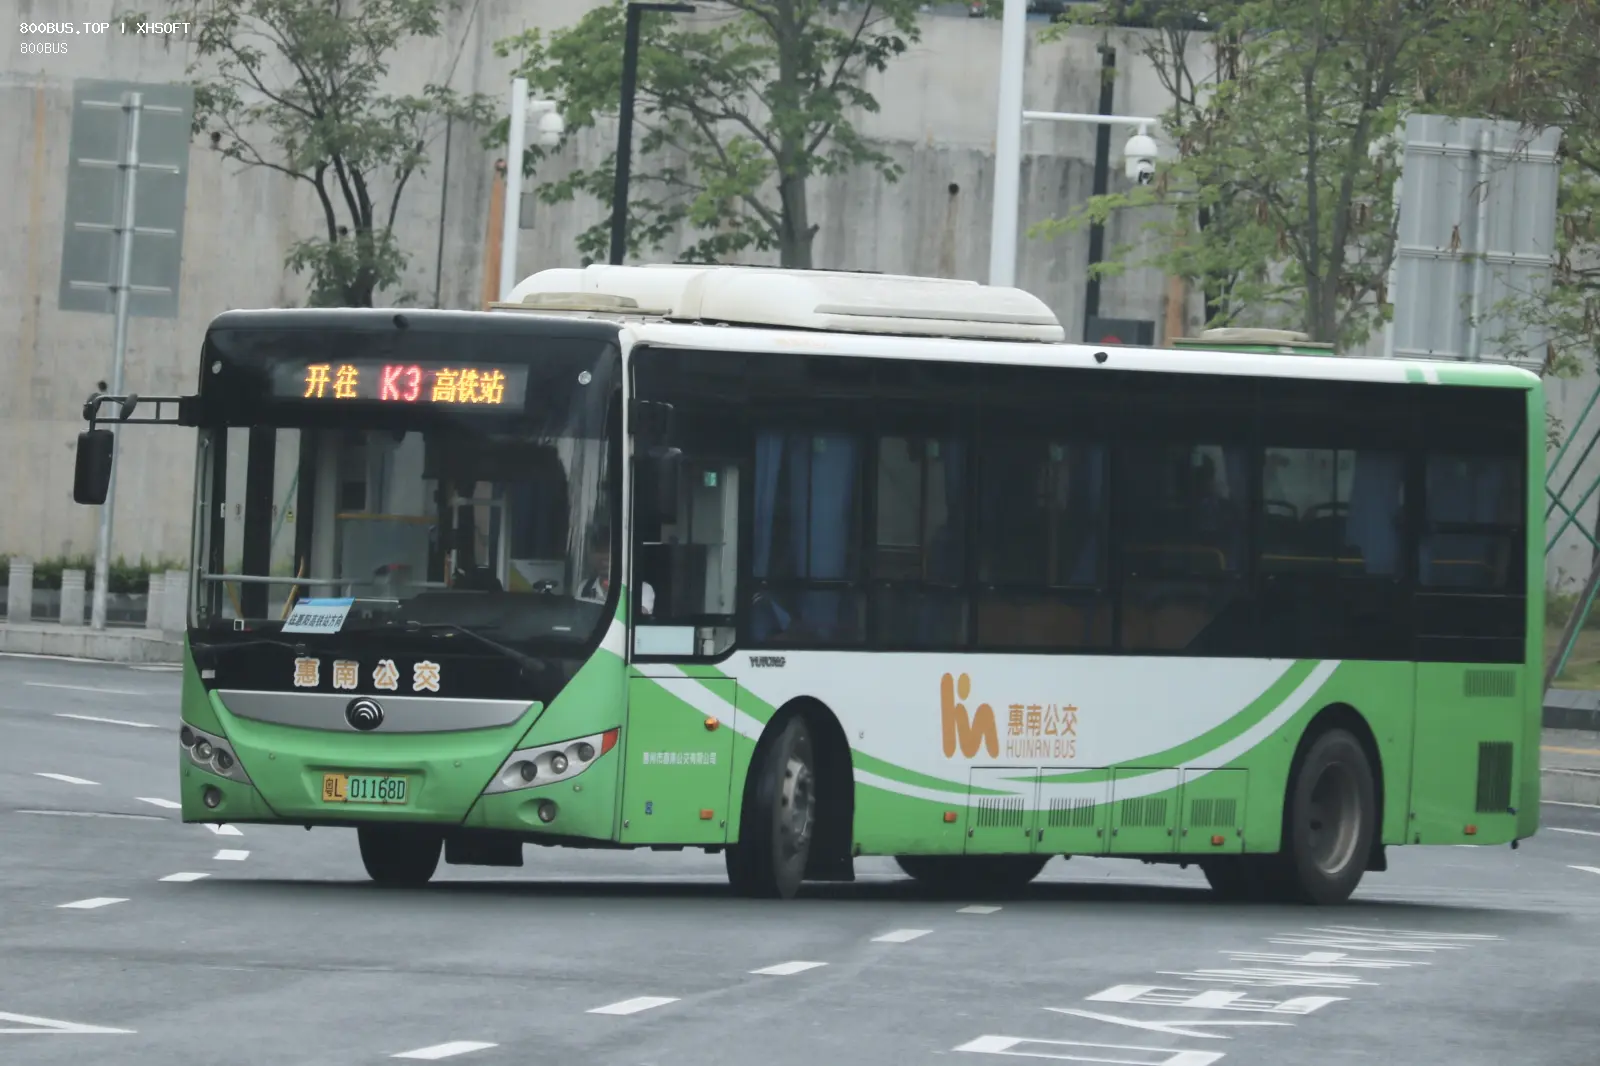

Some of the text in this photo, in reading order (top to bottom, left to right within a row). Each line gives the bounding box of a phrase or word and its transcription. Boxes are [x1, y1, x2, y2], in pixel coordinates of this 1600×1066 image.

[304, 364, 505, 404] 开往 K3 高铁站
[293, 656, 441, 692] 惠南公交
[1007, 703, 1079, 737] 惠南公交
[1006, 739, 1077, 759] HUINAN BUS
